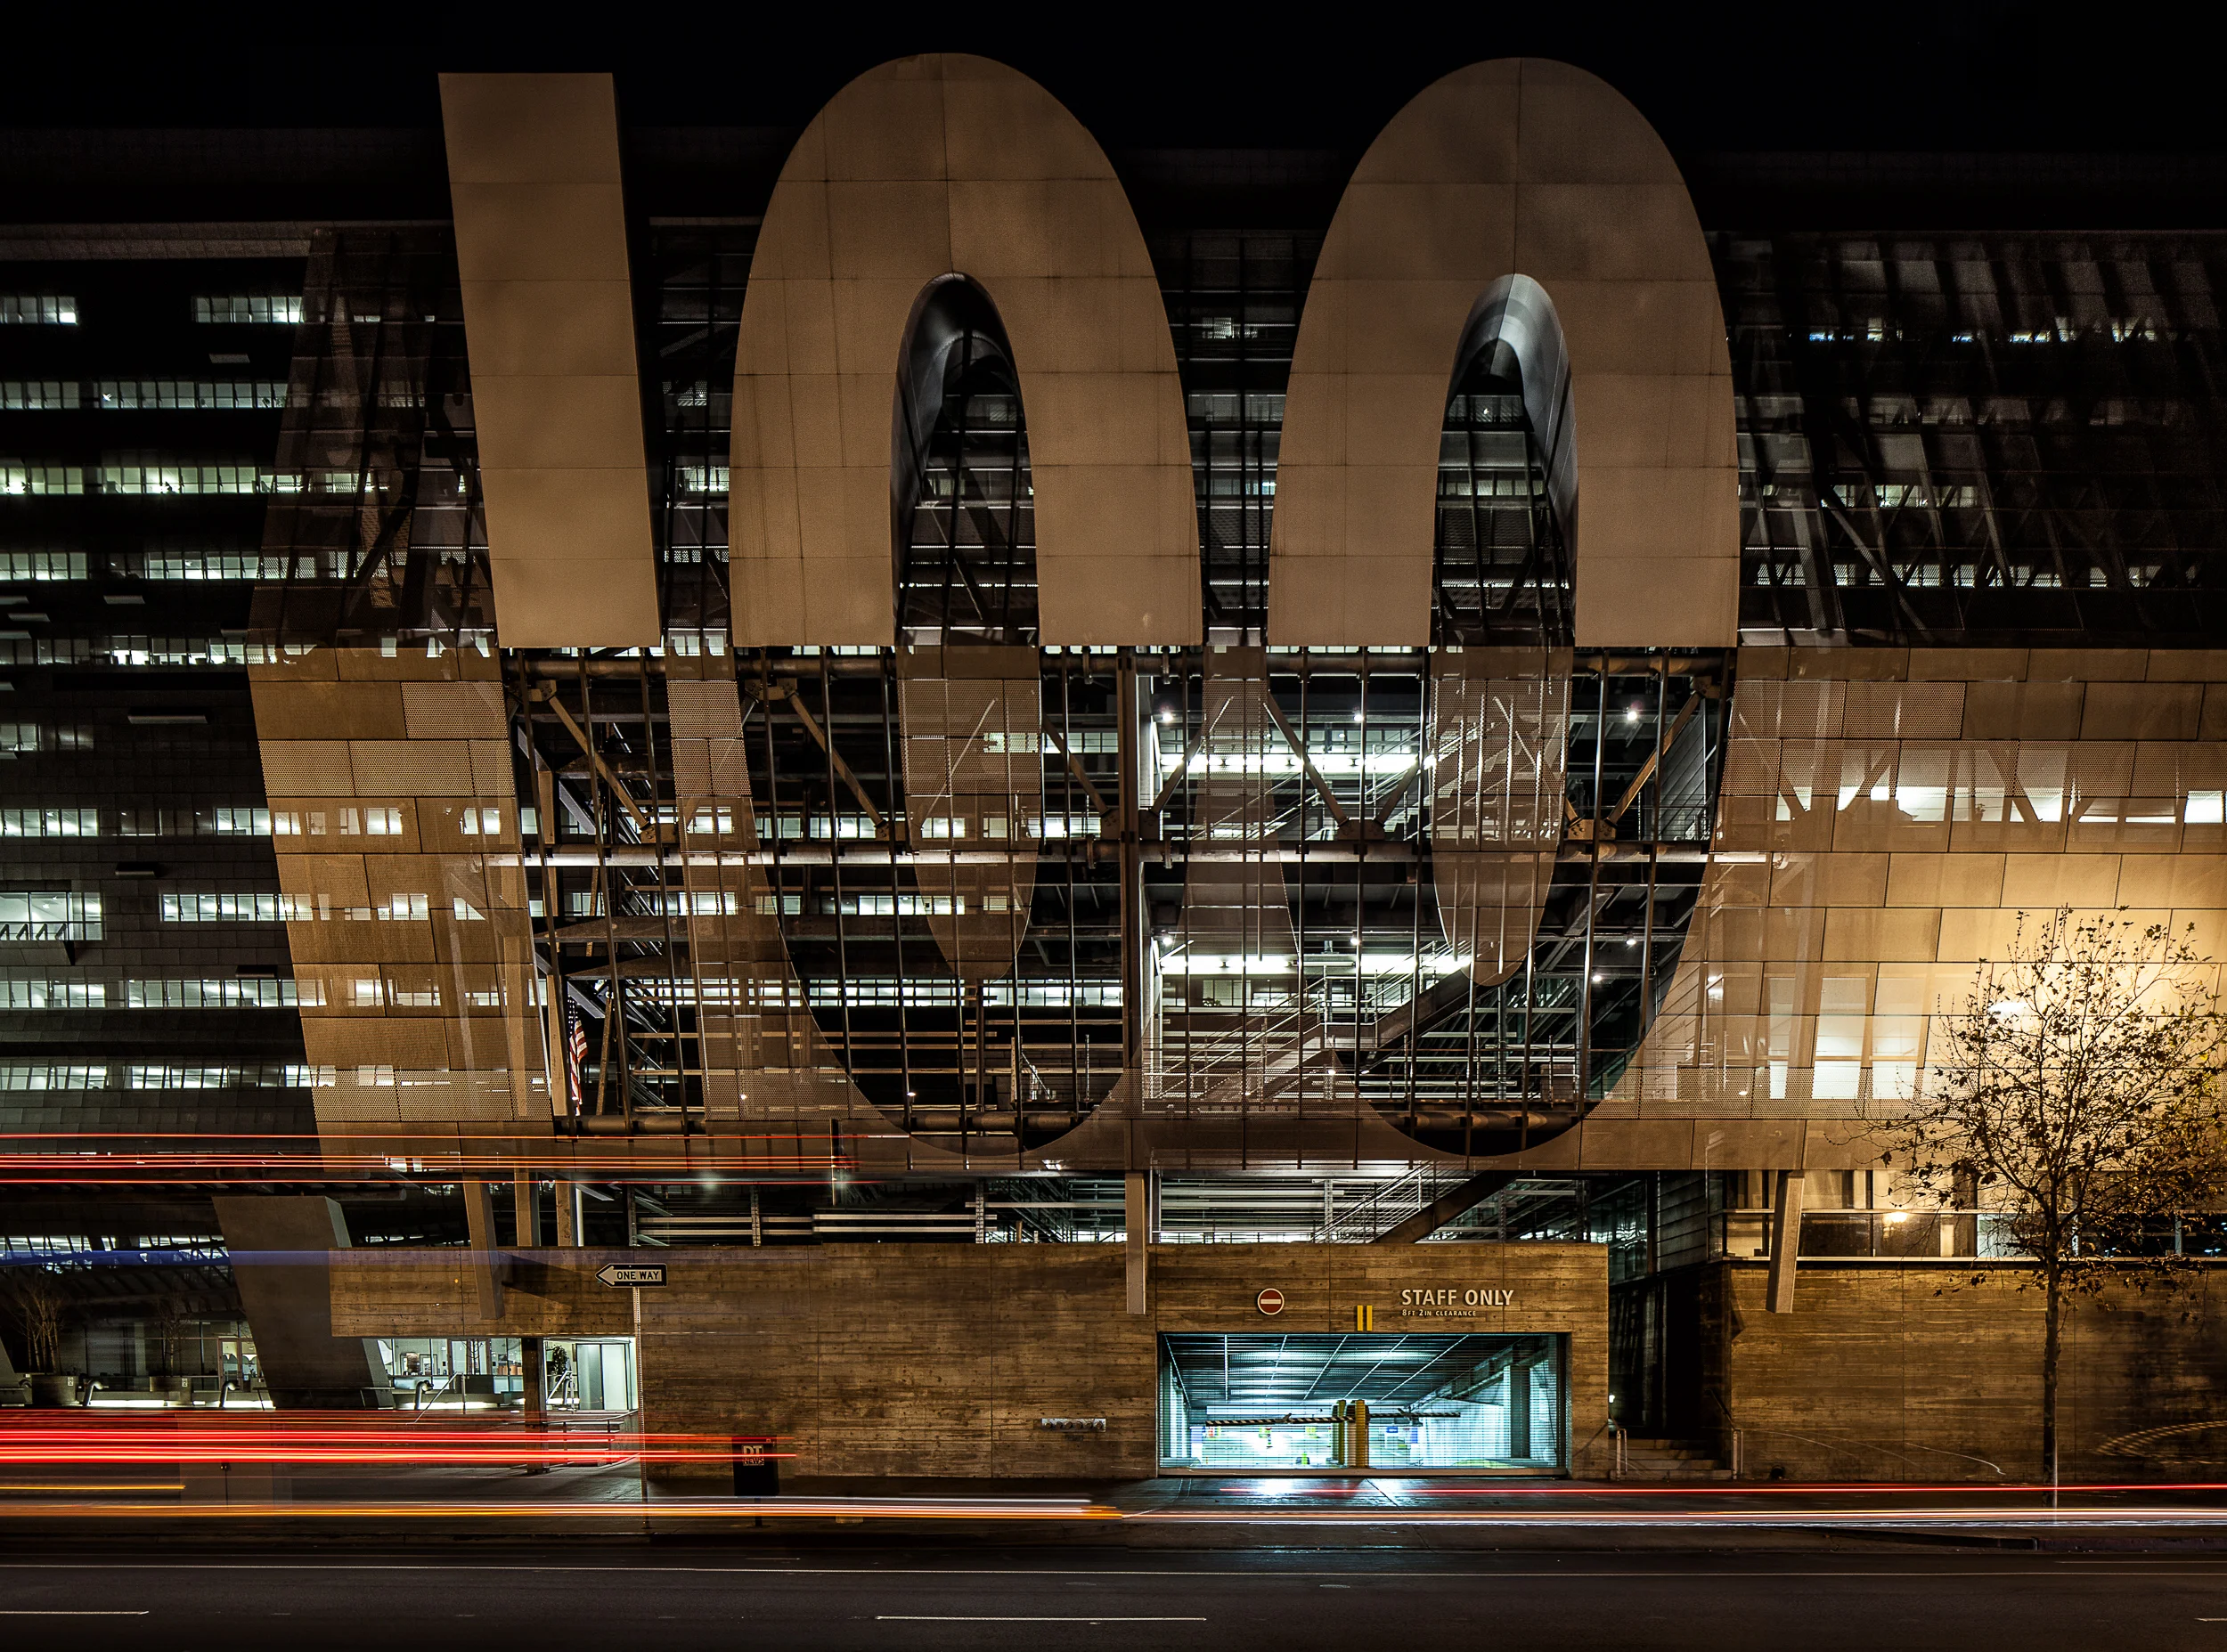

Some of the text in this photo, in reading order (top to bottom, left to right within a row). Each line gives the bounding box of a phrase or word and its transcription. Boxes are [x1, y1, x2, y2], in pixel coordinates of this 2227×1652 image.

[438, 53, 1742, 1155] 100
[616, 1271, 659, 1280] ONE WAY
[1401, 1289, 1514, 1306] STAFF ONLY
[743, 1445, 763, 1456] DT
